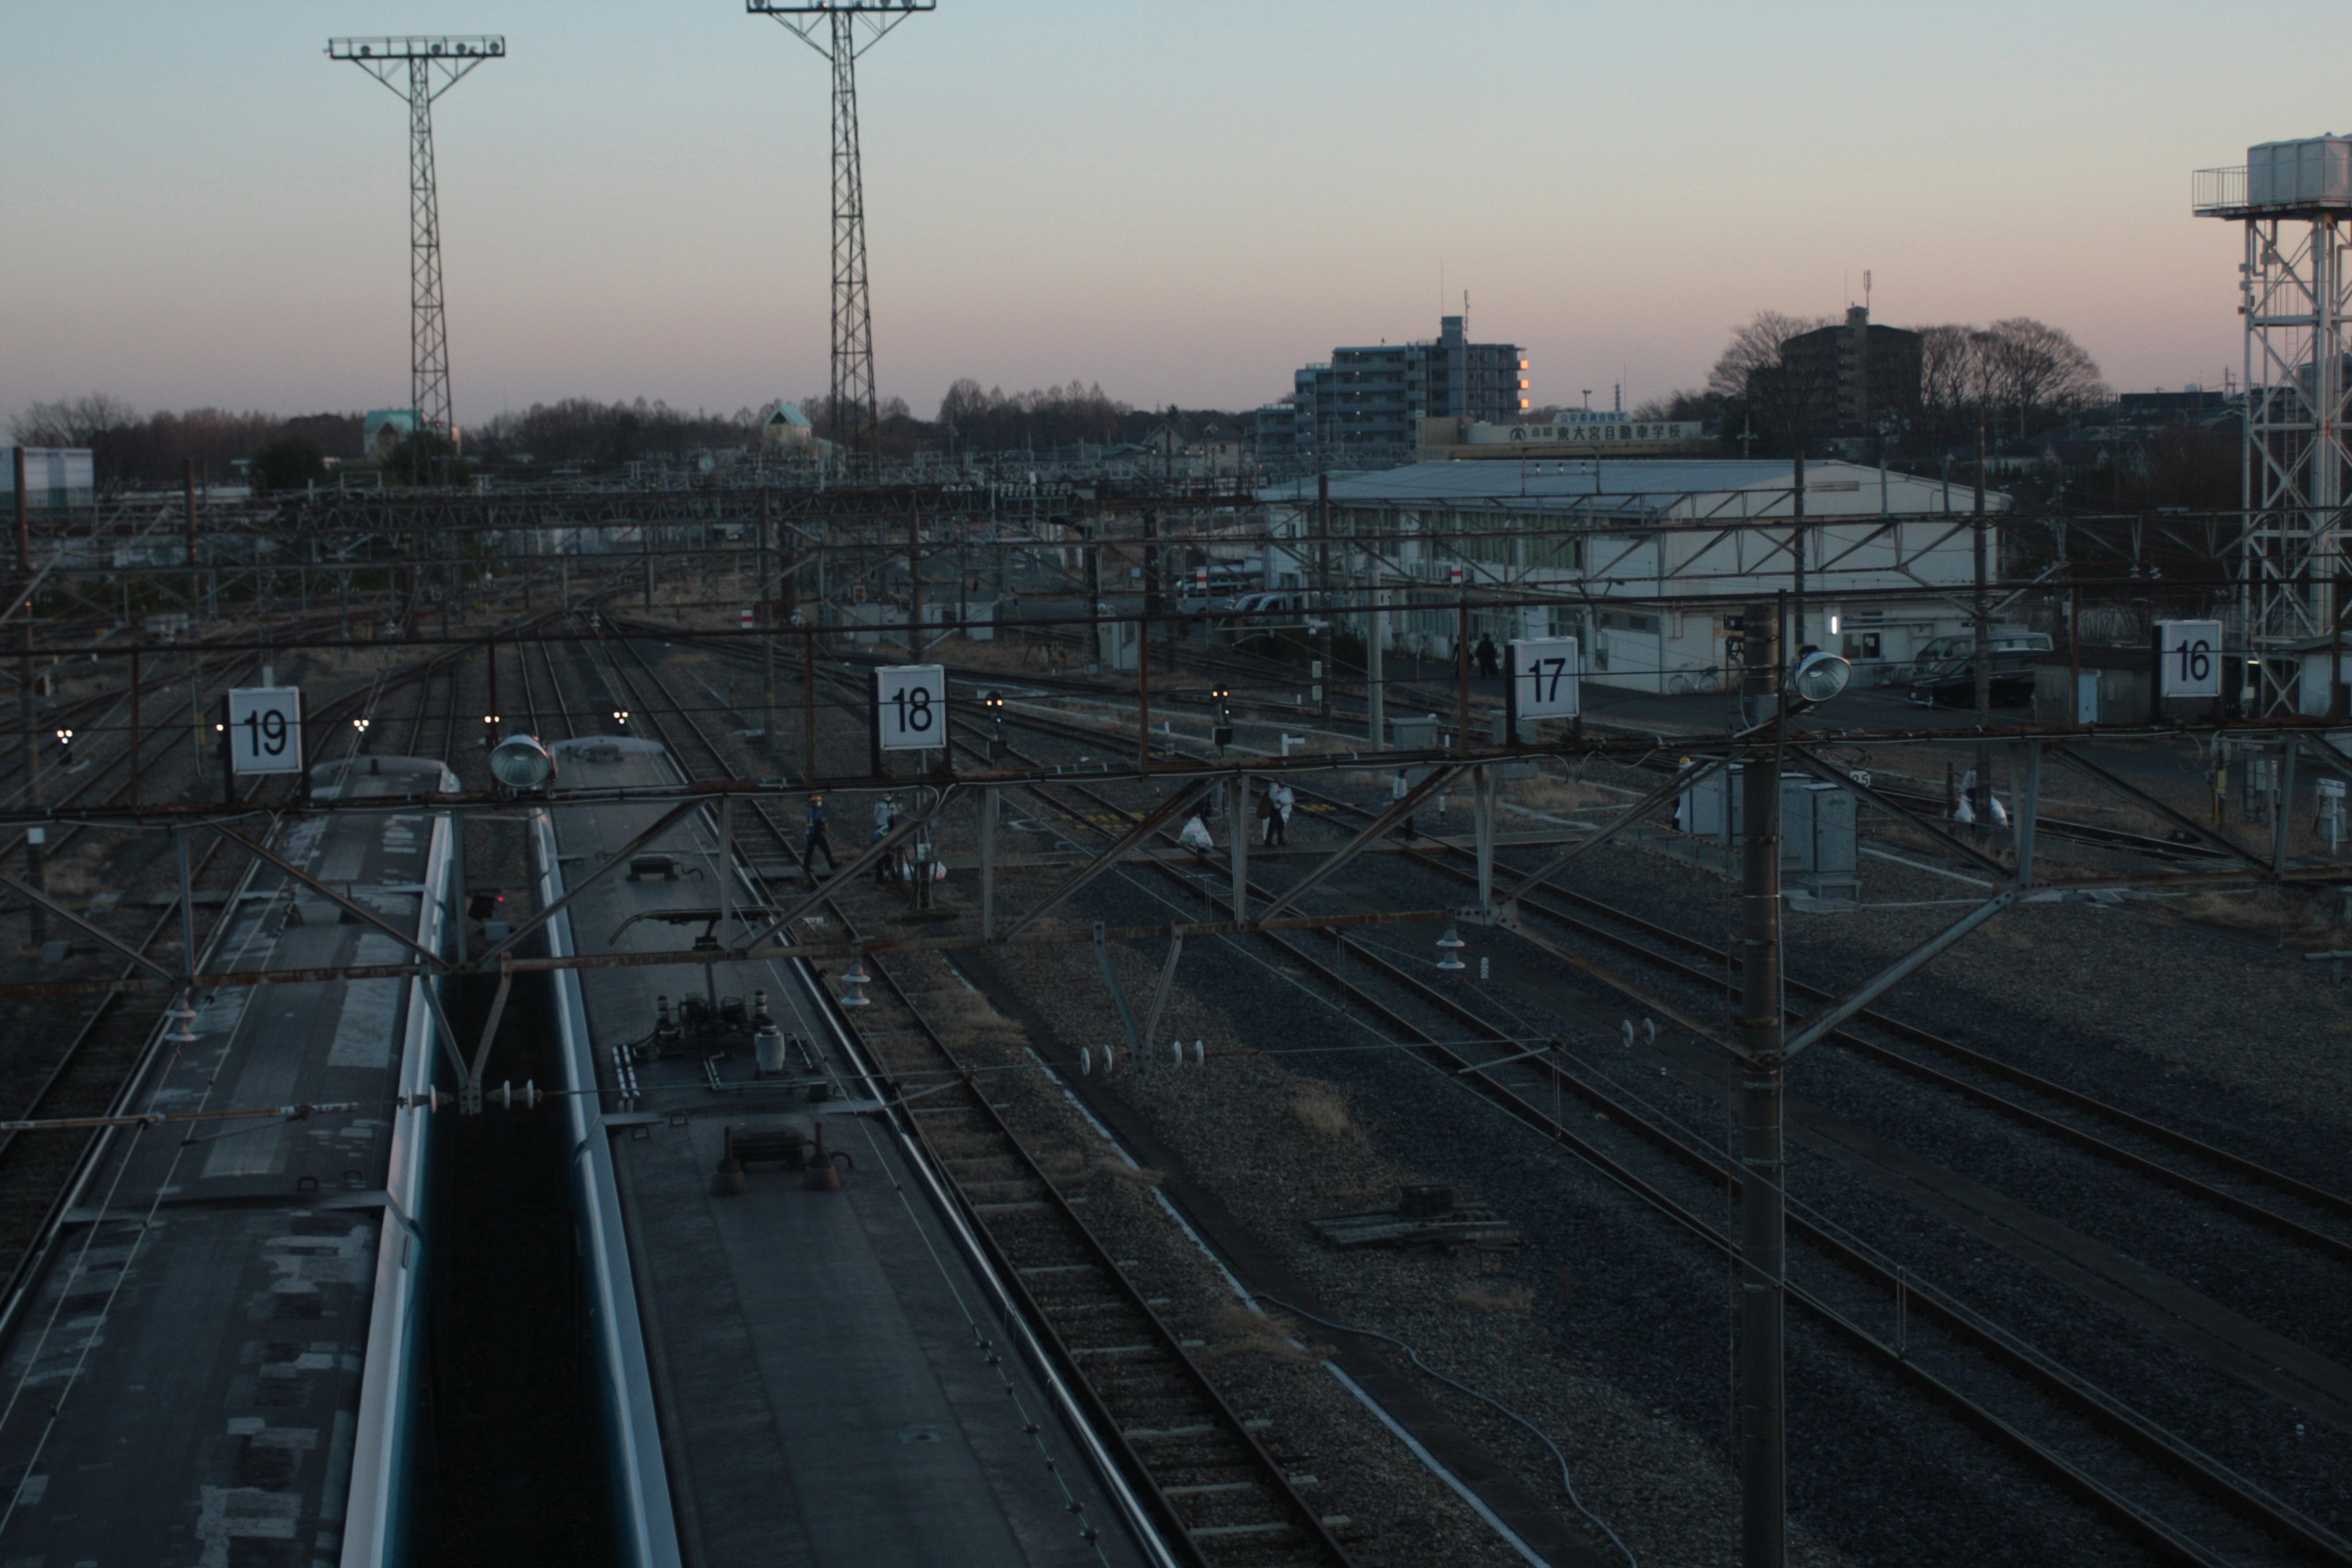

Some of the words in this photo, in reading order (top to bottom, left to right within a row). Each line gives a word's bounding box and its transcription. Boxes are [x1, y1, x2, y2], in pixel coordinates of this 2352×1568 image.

[1558, 424, 1680, 441] 東大宮自動車学校
[1529, 658, 1566, 702] 17
[2177, 640, 2209, 681] 16
[892, 687, 932, 733] 18
[244, 709, 286, 756] 19
